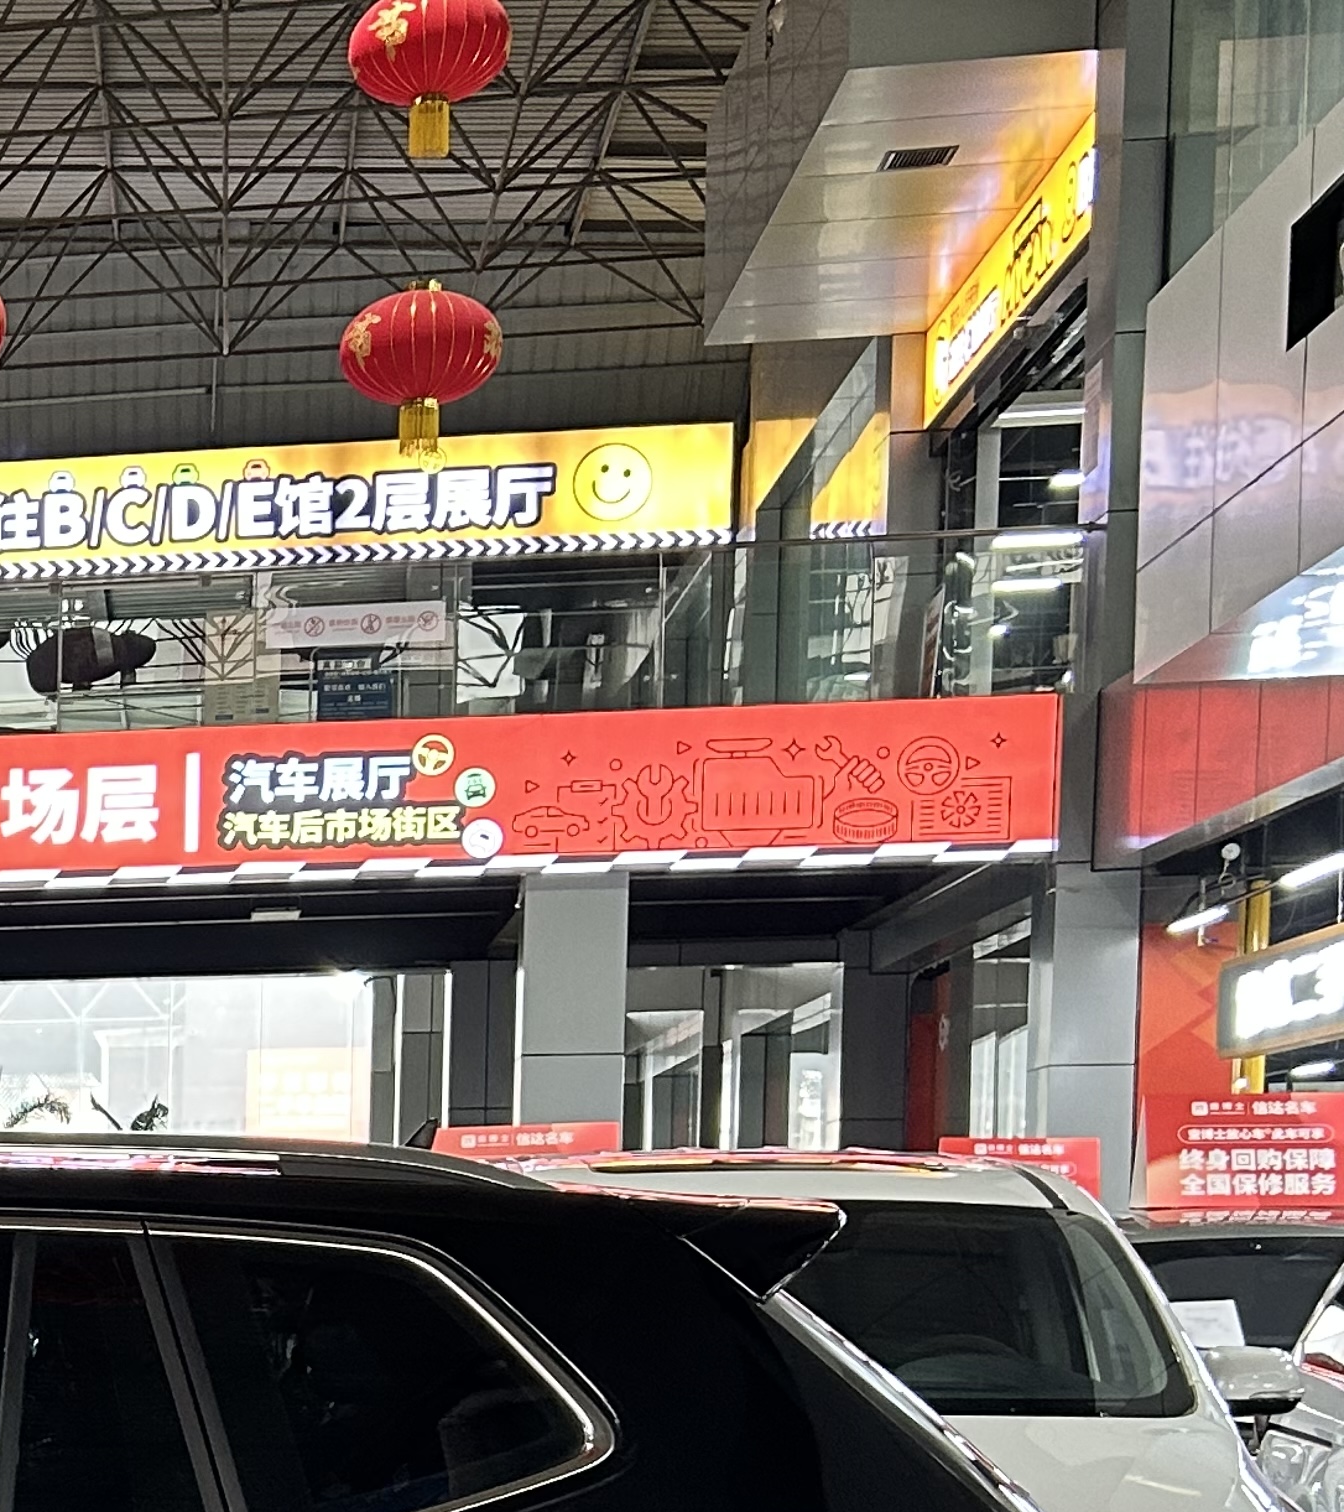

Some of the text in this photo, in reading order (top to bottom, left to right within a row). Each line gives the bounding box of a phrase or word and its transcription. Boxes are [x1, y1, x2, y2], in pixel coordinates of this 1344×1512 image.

[228, 755, 414, 804] 汽车展厅
[222, 806, 463, 846] 汽车后市场街区
[1251, 1100, 1318, 1116] 信达名车
[515, 1131, 575, 1147] 信达名车
[1178, 1148, 1336, 1172] 终身回购保障
[1179, 1172, 1336, 1196] 全国保修服务
